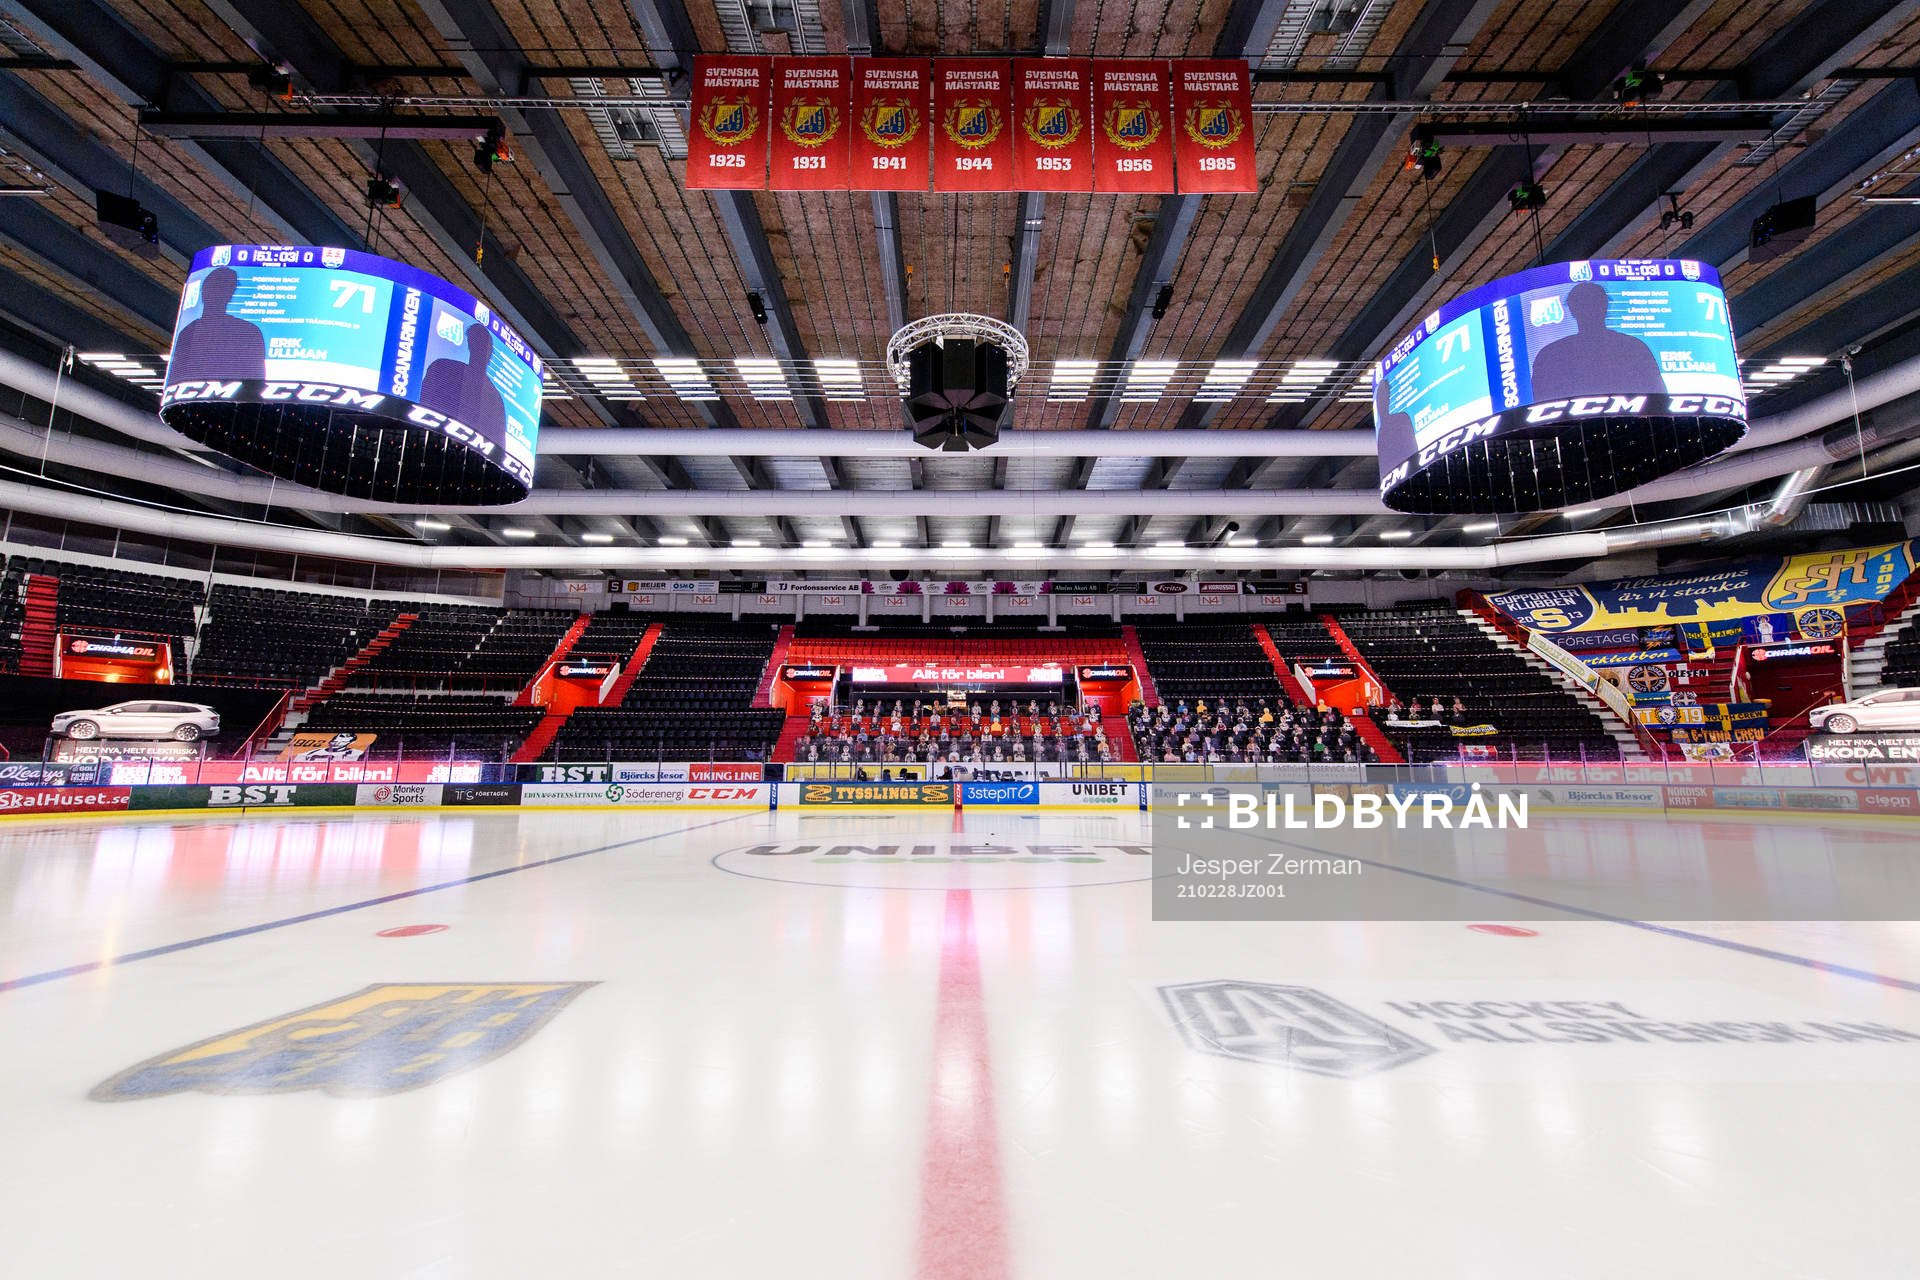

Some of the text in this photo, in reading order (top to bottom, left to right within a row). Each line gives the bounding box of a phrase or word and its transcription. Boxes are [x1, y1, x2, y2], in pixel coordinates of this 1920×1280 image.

[706, 68, 759, 77] SVENSKA
[785, 69, 839, 78] SVENSKA
[865, 70, 918, 80] SVENSKA
[945, 70, 999, 80] SVENSKA
[1025, 70, 1079, 80] SVENSKA
[1104, 72, 1157, 81] SVENSKA
[1184, 72, 1237, 81] SVENSKA
[704, 77, 760, 88] MÄSTARE
[783, 78, 839, 89] MÄSTARE
[863, 79, 919, 90] MÄSTARE
[945, 79, 1000, 90] MÄSTARE
[1024, 80, 1080, 91] MÄSTARE
[1103, 81, 1159, 92] MÄSTARE
[1184, 81, 1239, 92] MÄSTARE
[709, 154, 746, 168] 1925
[792, 156, 826, 169] 1931
[872, 156, 907, 170] 1941
[955, 157, 992, 171] 1944
[1035, 157, 1072, 171] 1953
[1116, 158, 1152, 172] 1956
[1198, 157, 1236, 171] 1985
[238, 250, 248, 261] 0
[303, 252, 313, 262] 0
[1600, 265, 1609, 276] 0
[1664, 265, 1675, 275] 0
[330, 279, 376, 314] 71
[1696, 292, 1727, 325] 71
[270, 337, 302, 348] ERIK
[1436, 324, 1471, 365] 71
[268, 348, 328, 360] ULLMAN
[1660, 351, 1693, 361] ERIK
[1661, 362, 1717, 372] ULLMAN
[260, 382, 385, 409] CCM
[1527, 396, 1647, 423] CCM
[408, 404, 495, 455] CCM
[1418, 415, 1501, 466] CCM
[503, 453, 534, 488] CC
[1612, 569, 1749, 591] Tillsammans
[610, 582, 619, 591] S
[778, 583, 788, 591] TJ
[1295, 584, 1303, 592] S
[1618, 581, 1751, 601] är vi starka
[1494, 588, 1581, 606] SUPPORTER
[1507, 597, 1577, 612] KLUBBEN
[1529, 607, 1572, 629] S
[1567, 611, 1584, 619] 13
[1557, 632, 1639, 648] FÖRETAGEN
[912, 668, 1005, 680] Allt för bilen!
[1668, 669, 1707, 678] OLESEN
[1706, 711, 1763, 722] YOUTH CREW
[1811, 745, 1884, 758] ŠKODA
[237, 766, 392, 781] Allt för bilen!
[541, 767, 608, 782] BST
[619, 771, 656, 782] Björcks
[691, 772, 760, 780] VIKING LINE
[1536, 767, 1693, 782] Allt för bilen!
[1845, 767, 1913, 784] CWT
[208, 785, 297, 804] BST
[393, 785, 425, 795] Monkey
[625, 784, 684, 800] Söderenergi
[688, 788, 758, 799] CCM
[836, 786, 919, 800] TYSSLINGE
[968, 788, 1017, 802] 3stepIT
[1073, 784, 1128, 795] UNIBET
[1667, 787, 1707, 797] NORDISK
[392, 793, 424, 803] Sports
[1568, 791, 1654, 802] Björcks Resor
[1669, 796, 1697, 806] KRAFT
[1865, 795, 1911, 805] clean
[745, 845, 1158, 856] UNIBET
[1384, 1000, 1648, 1020] HOCKEY
